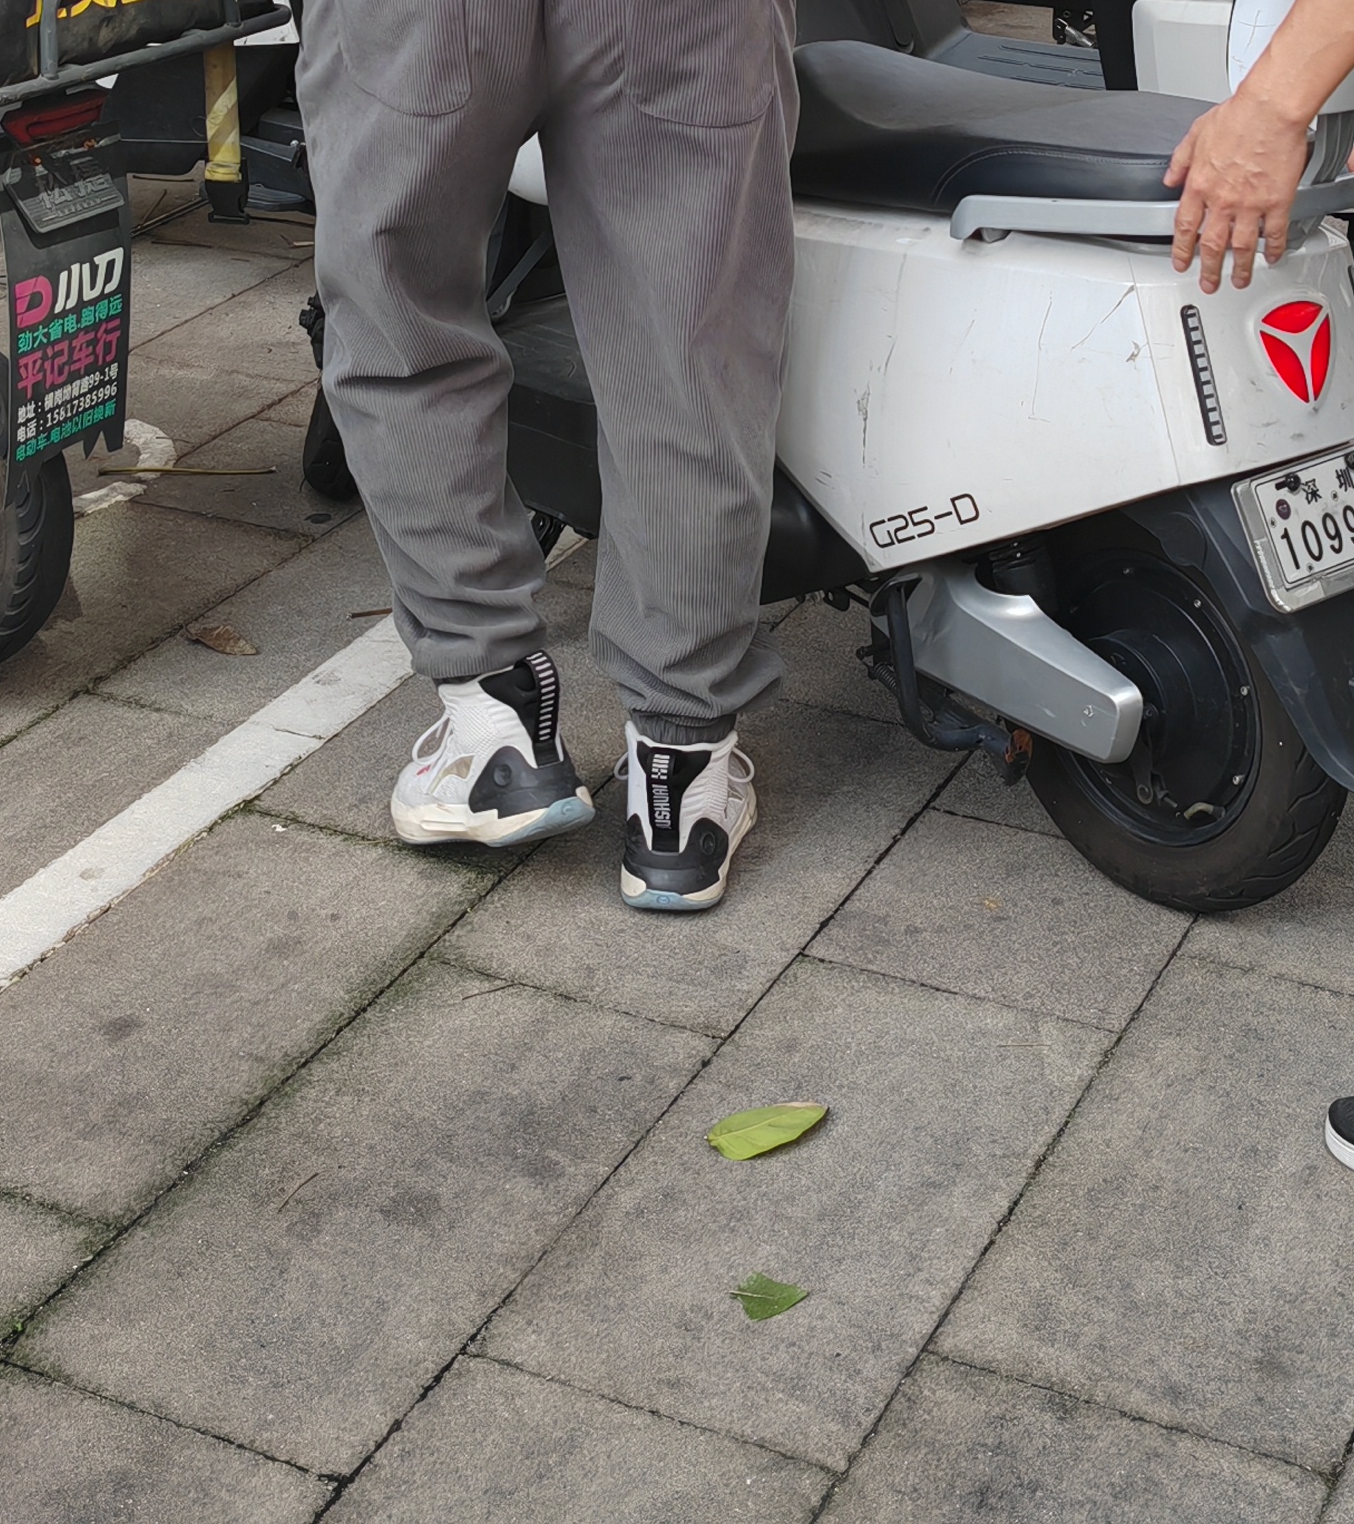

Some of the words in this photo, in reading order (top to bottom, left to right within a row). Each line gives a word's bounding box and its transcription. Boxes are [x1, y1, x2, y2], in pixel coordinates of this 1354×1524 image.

[16, 318, 122, 400] 平记车行
[869, 492, 980, 549] G25-D
